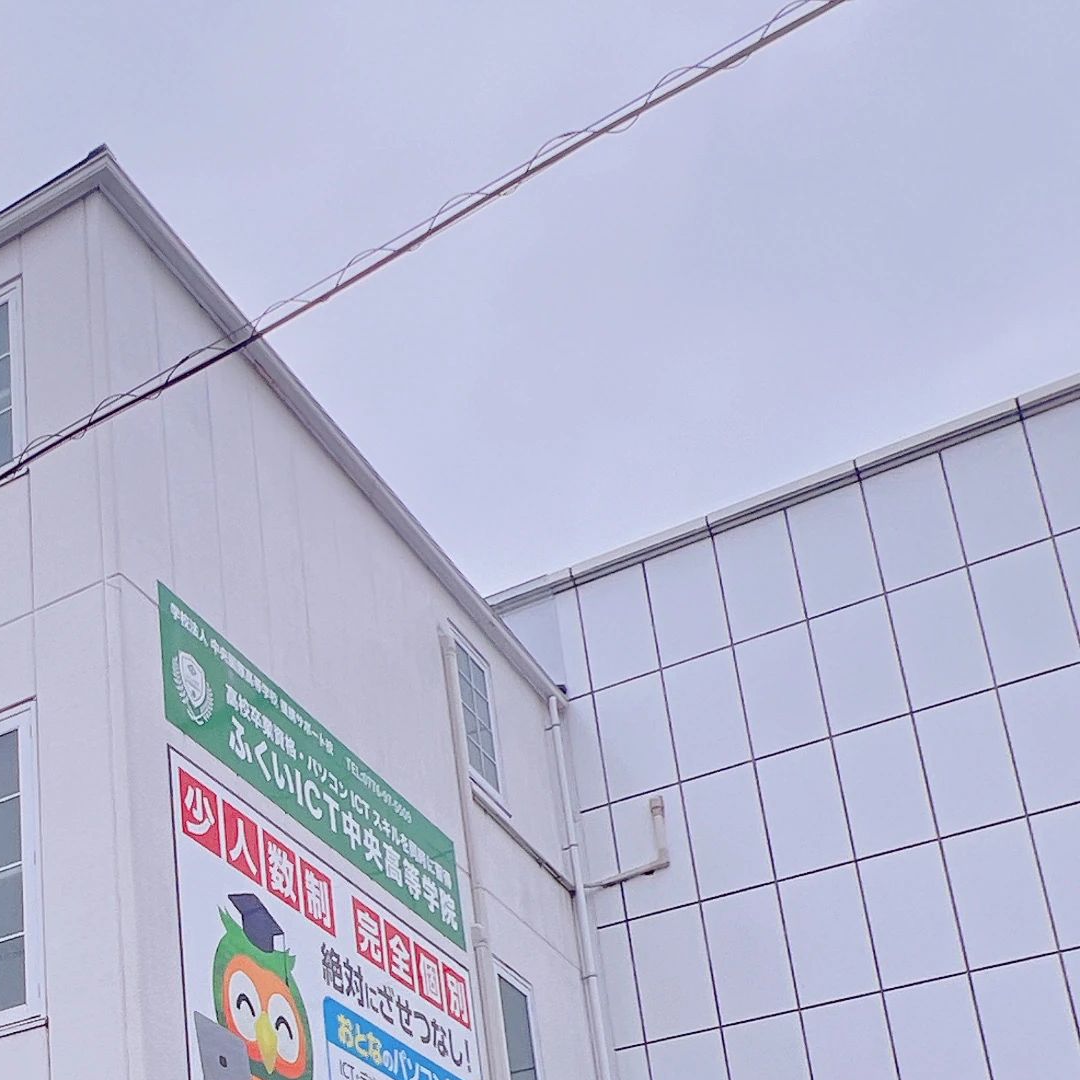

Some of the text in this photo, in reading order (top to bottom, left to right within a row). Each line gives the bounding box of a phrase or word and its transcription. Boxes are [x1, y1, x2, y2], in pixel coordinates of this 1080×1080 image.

[184, 782, 469, 1026] 少人数制 完全個別
[227, 712, 458, 931] ふくいICT中央高等学院
